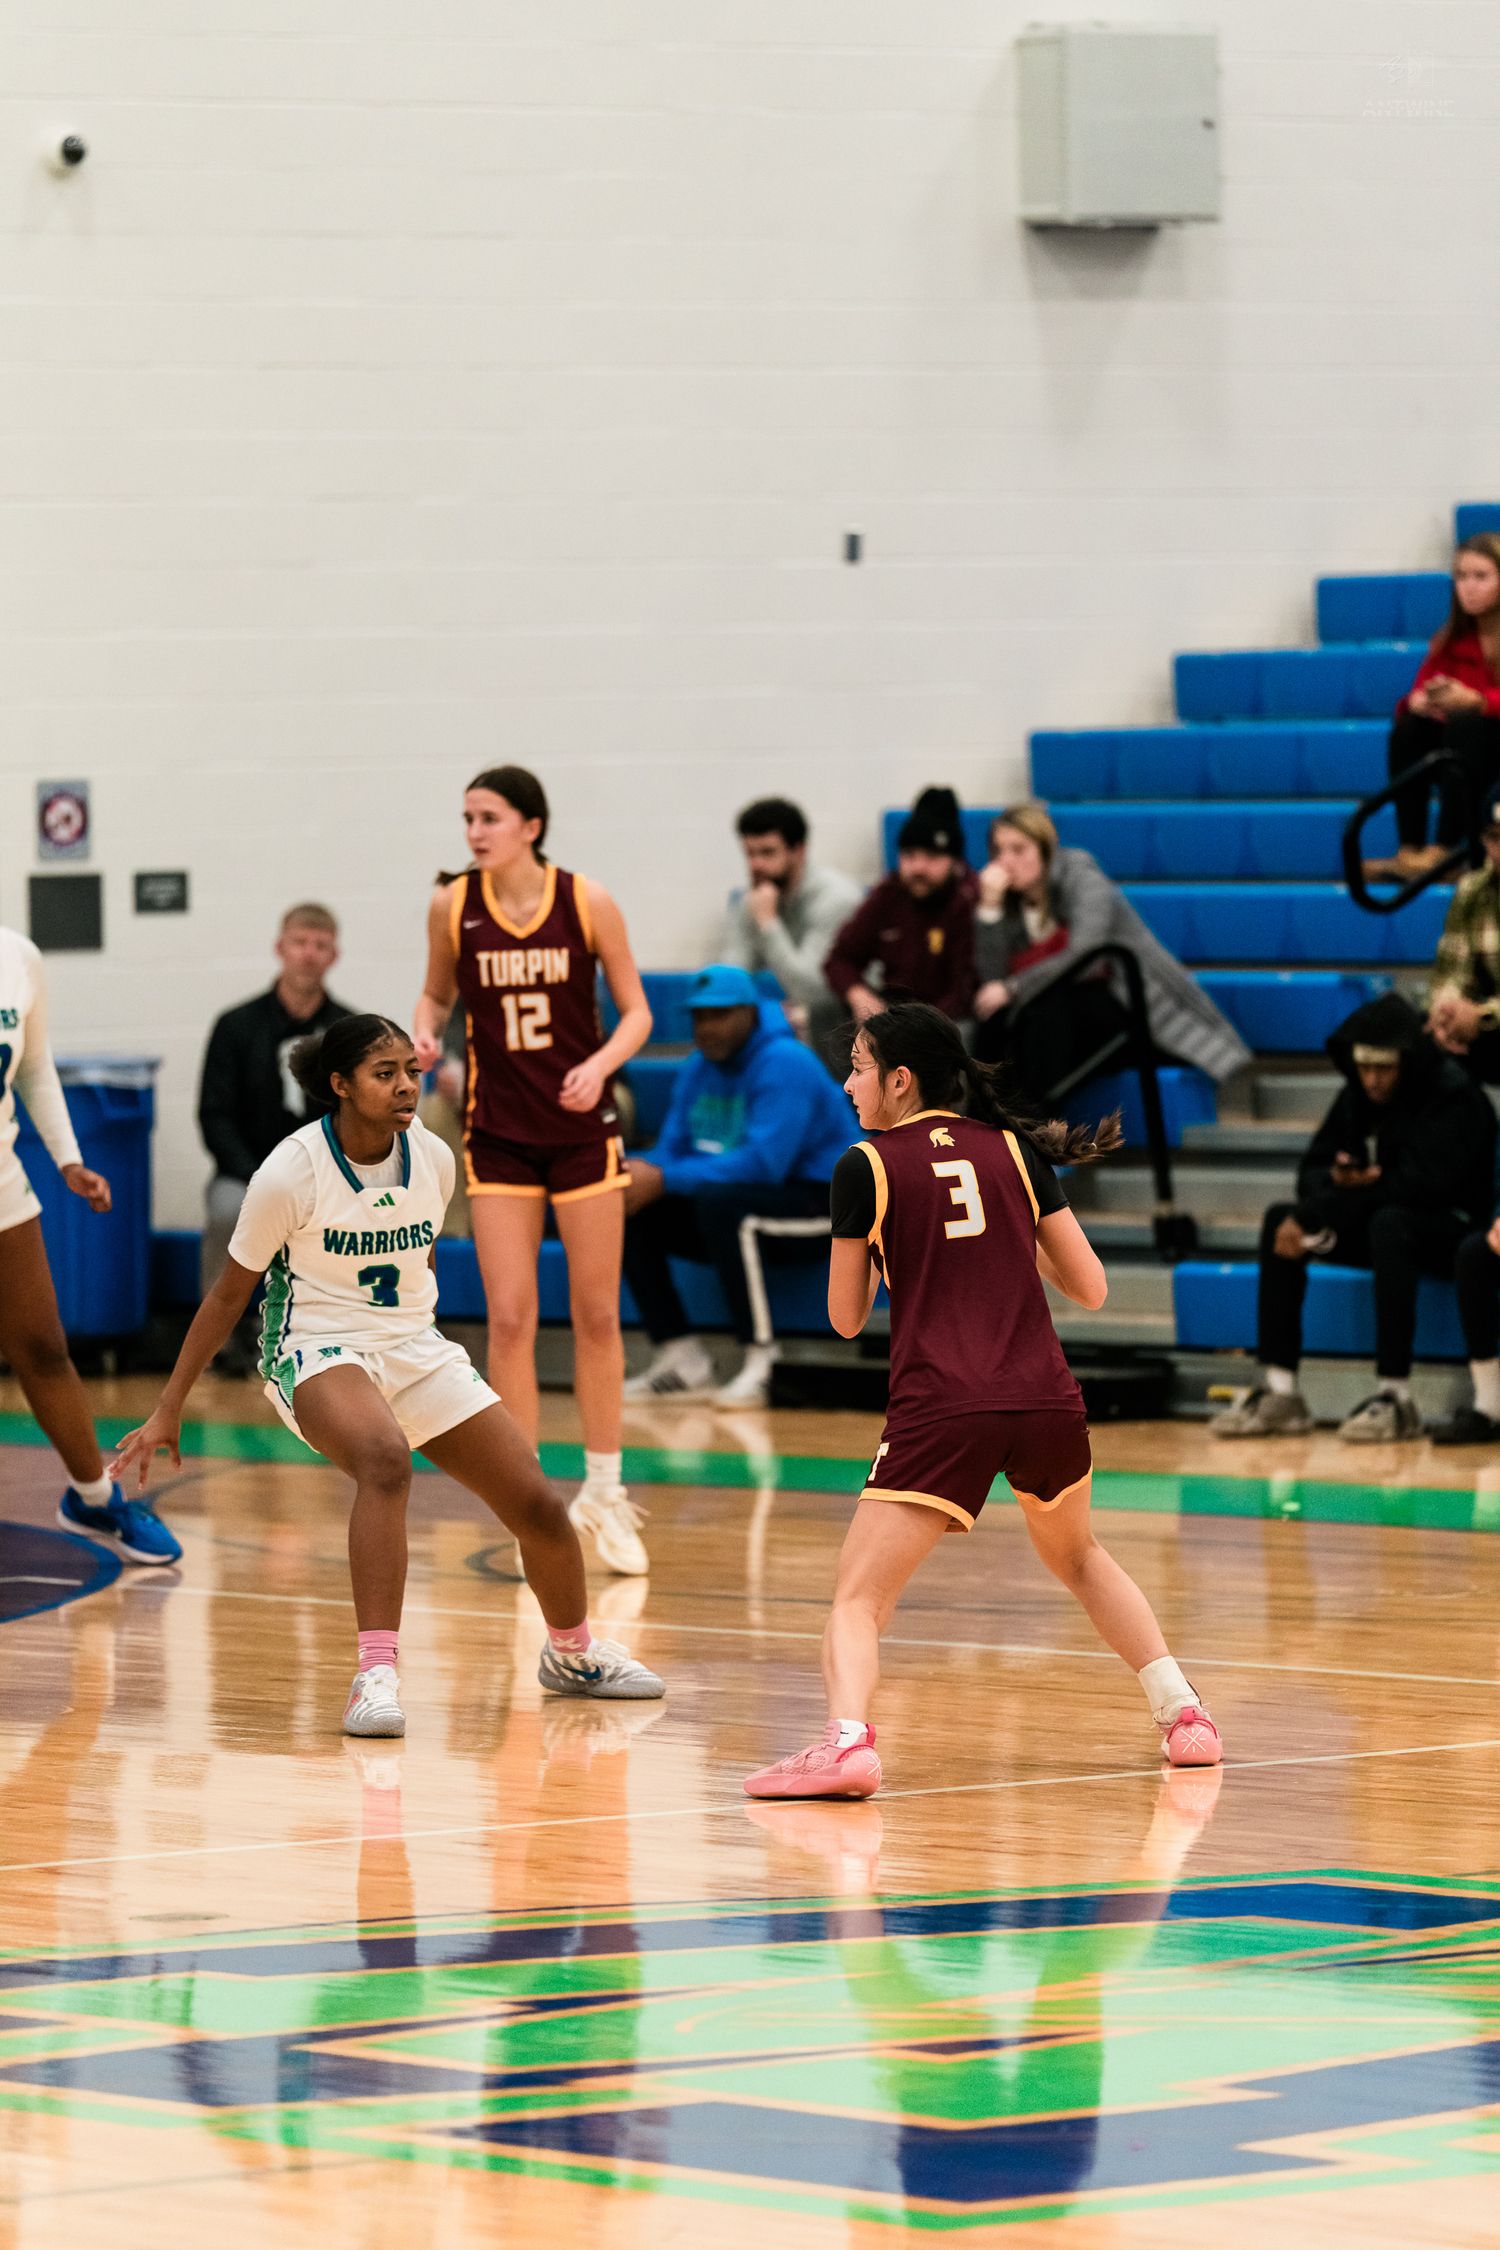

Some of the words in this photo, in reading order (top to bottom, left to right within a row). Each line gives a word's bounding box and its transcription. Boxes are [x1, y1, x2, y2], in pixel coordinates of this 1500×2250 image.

[476, 947, 569, 987] TURPIN
[501, 992, 554, 1051] 12
[931, 1159, 986, 1240] 3
[323, 1220, 433, 1256] WARRIORS
[357, 1263, 401, 1307] 3
